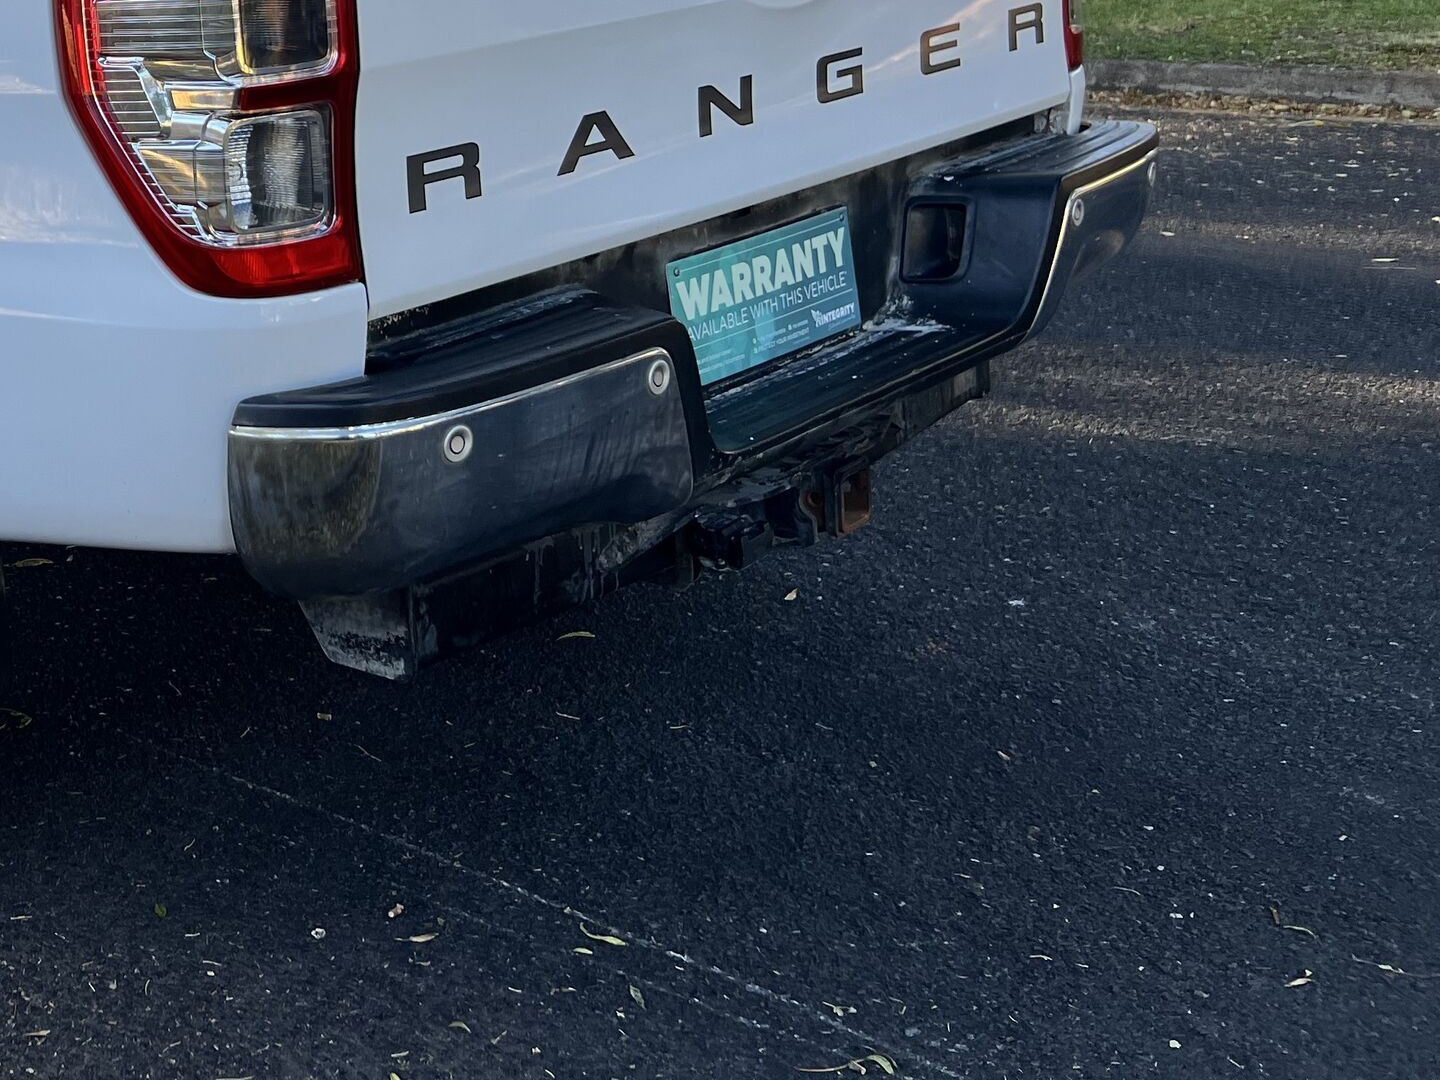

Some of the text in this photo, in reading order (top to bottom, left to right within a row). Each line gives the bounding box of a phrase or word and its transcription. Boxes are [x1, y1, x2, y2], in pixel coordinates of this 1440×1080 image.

[406, 2, 1045, 214] RANGER
[675, 226, 846, 320] WARRANTY
[687, 306, 749, 342] AVAILABLE
[749, 296, 779, 320] WITH
[779, 287, 803, 311] THIS
